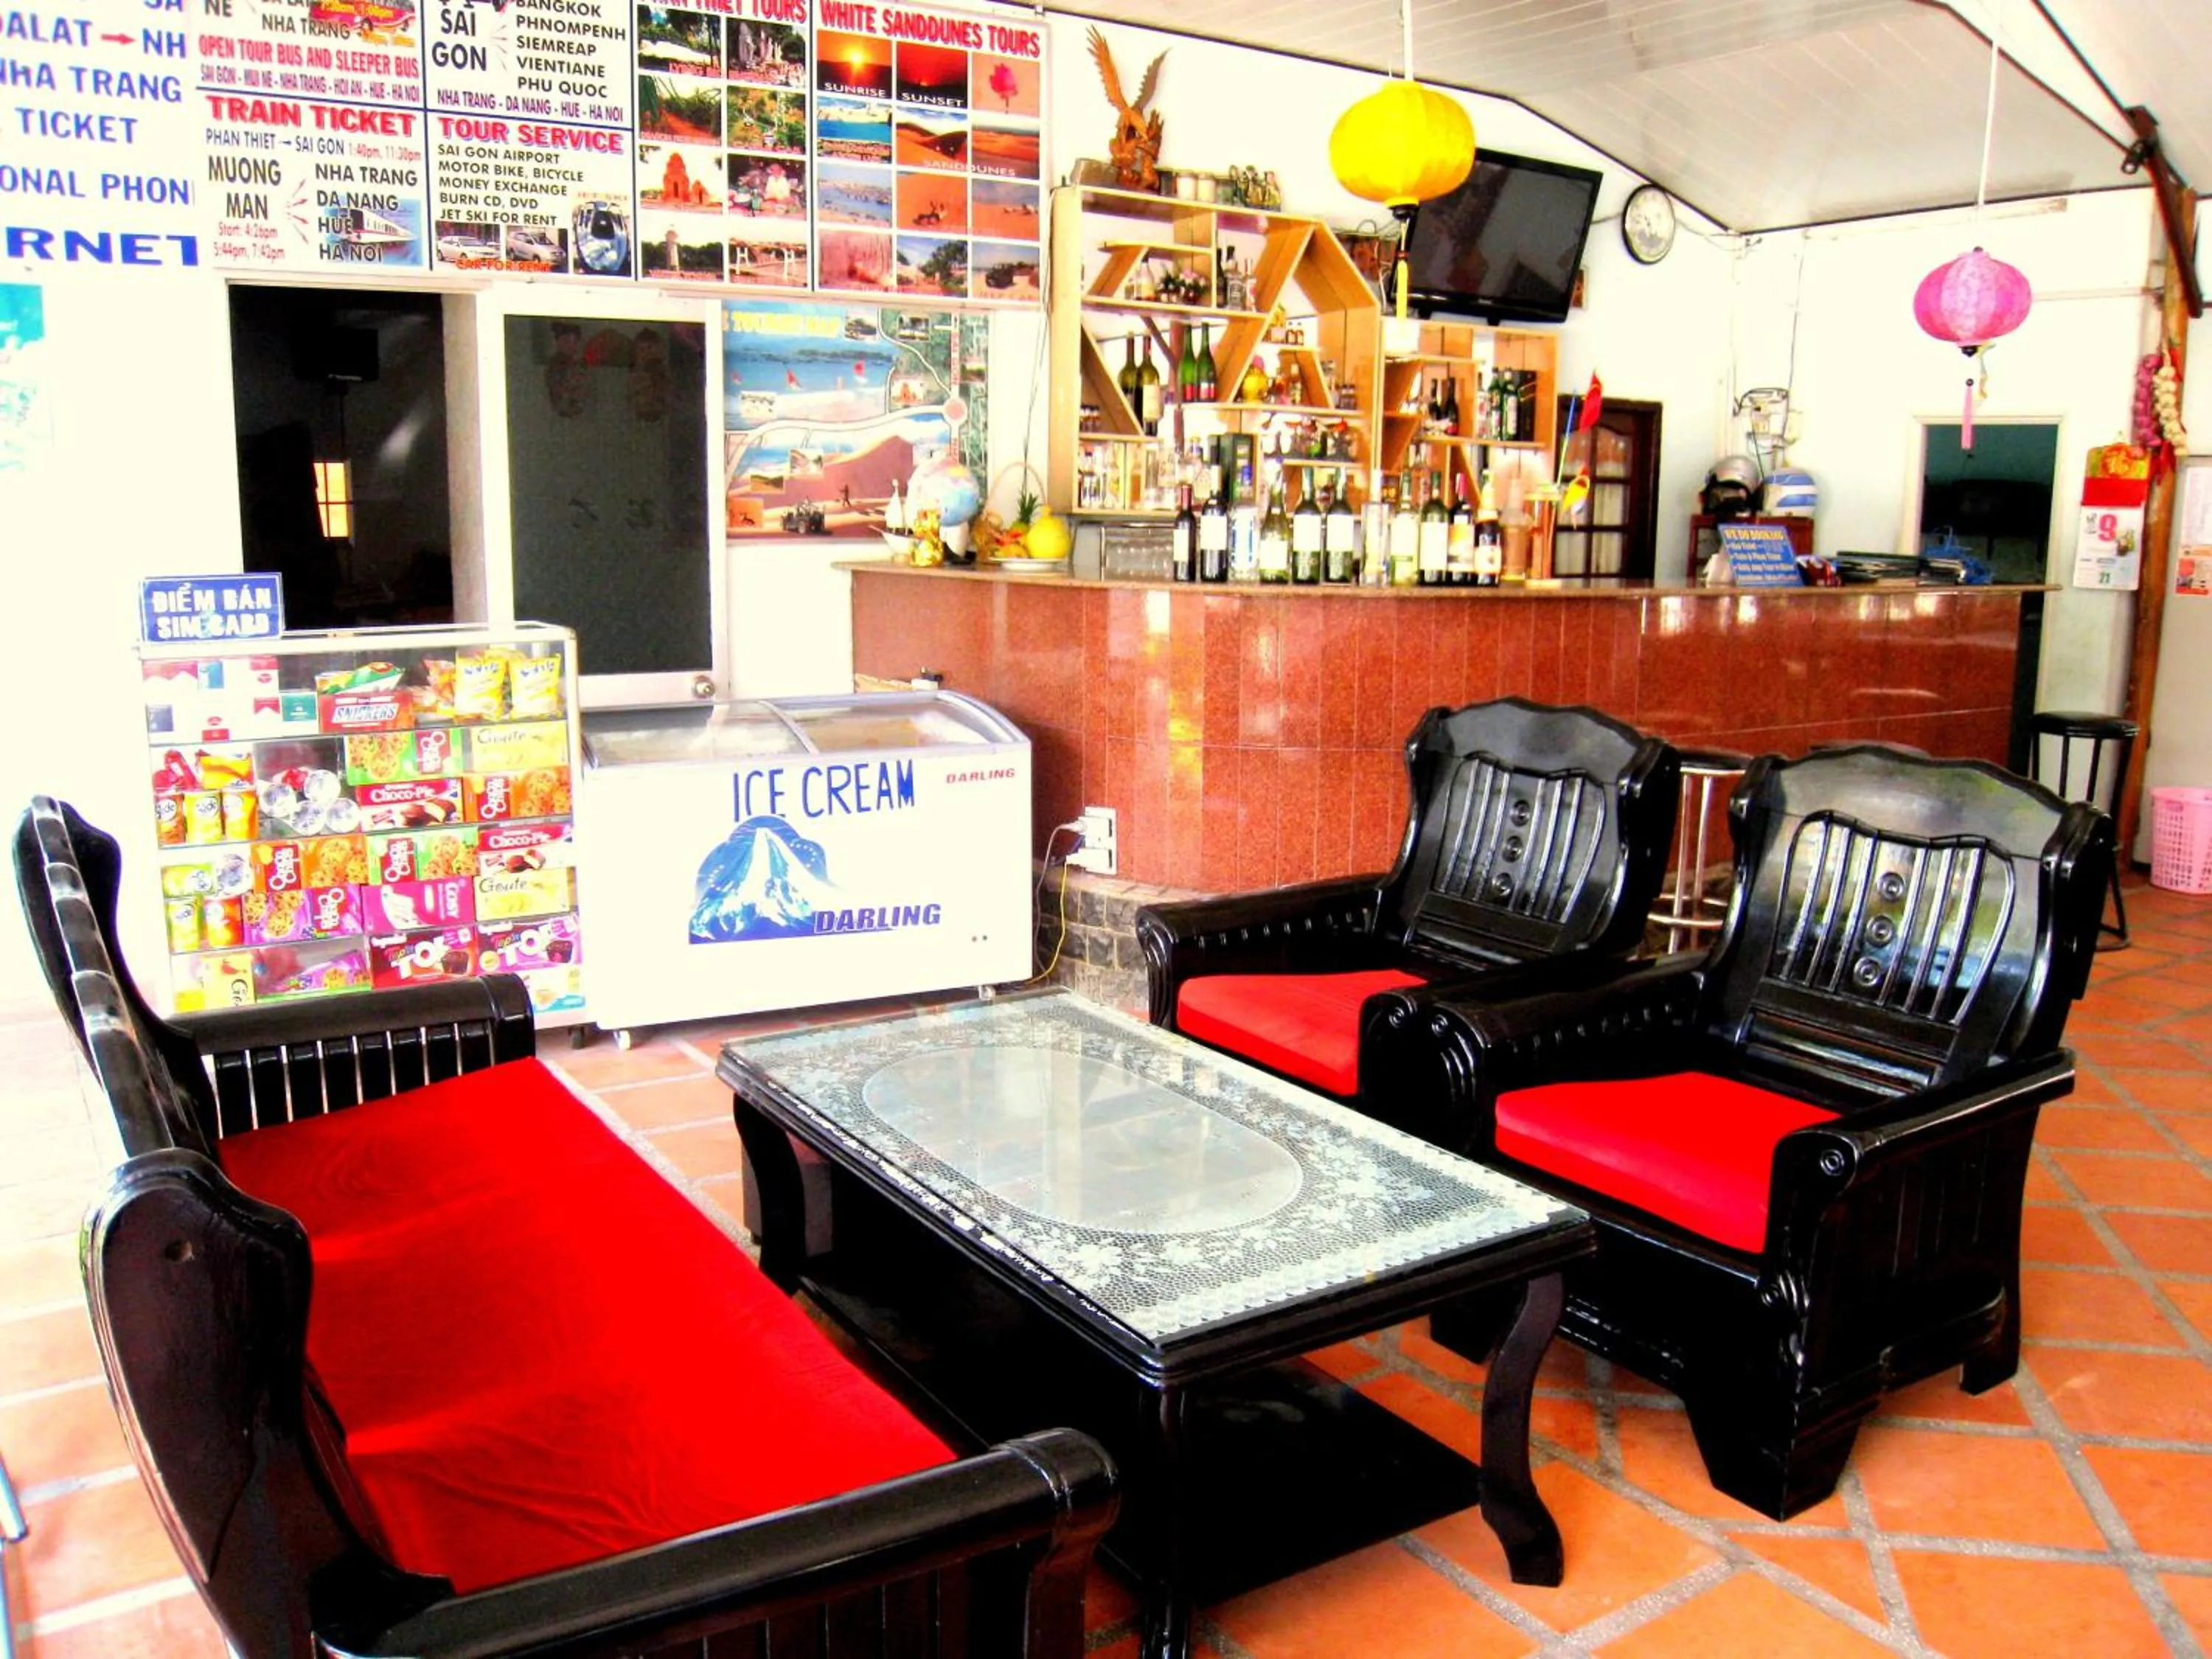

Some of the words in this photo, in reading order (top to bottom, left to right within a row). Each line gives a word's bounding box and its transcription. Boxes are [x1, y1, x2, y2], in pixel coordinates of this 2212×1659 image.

[516, 0, 602, 18] BANGKOK
[753, 0, 807, 24] TOURS
[262, 13, 296, 33] NHA
[300, 18, 350, 39] TRANG
[440, 8, 477, 37] SAI
[516, 14, 626, 41] PHNOMPENH
[818, 0, 877, 34] WHITE
[882, 8, 983, 49] SANDDUNES
[987, 25, 1040, 58] TOURS
[0, 11, 93, 47] ALAT
[142, 28, 186, 59] NH
[516, 35, 597, 57] SIEMREAP
[198, 35, 234, 58] OPEN
[237, 38, 273, 63] TOUR
[276, 43, 303, 67] BUS
[306, 46, 332, 70] AND
[335, 49, 391, 75] SLEEPER
[394, 56, 420, 79] BUS
[431, 41, 487, 72] GON
[516, 56, 606, 78] VIENTIANE
[68, 66, 181, 102] TRANG
[299, 73, 327, 94] TRANG
[518, 76, 552, 93] PHU
[558, 80, 608, 99] QUOC
[824, 82, 886, 98] SUNRISE
[437, 88, 460, 107] NHA
[462, 91, 496, 110] TRANG
[505, 95, 519, 111] DA
[521, 97, 552, 116] NANG
[561, 102, 581, 119] HUE
[589, 104, 603, 120] HA
[605, 107, 624, 123] NOI
[902, 92, 964, 107] SUNSET
[15, 107, 138, 144] TICKET
[205, 95, 302, 128] TRAIN
[309, 105, 417, 138] TICKET
[206, 128, 240, 147] PHAN
[243, 131, 276, 150] THIET
[295, 135, 313, 153] SAI
[317, 137, 344, 155] GON
[437, 116, 509, 145] TOUR
[517, 123, 625, 154] SERVICE
[437, 144, 461, 157] SAI
[465, 146, 499, 160] GON
[503, 149, 561, 164] AIRPORT
[208, 156, 282, 185] MUONG
[315, 163, 354, 182] NHA
[359, 167, 418, 187] TRANG
[438, 161, 490, 175] MOTOR
[494, 164, 529, 179] BIKE,
[532, 168, 585, 182] BICYCLE
[922, 160, 1016, 176] SANDDUNES
[101, 172, 189, 206] PHON
[438, 177, 490, 192] MONEY
[494, 181, 568, 196] EXCHANGE
[226, 192, 268, 220] MAN
[316, 189, 341, 207] DA
[347, 193, 399, 212] NANG
[439, 192, 479, 206] BURN
[483, 196, 506, 209] CD,
[509, 197, 540, 209] DVD
[318, 216, 354, 235] HUE
[439, 209, 462, 221] JET
[465, 210, 489, 223] SKI
[493, 212, 518, 224] FOR
[523, 215, 559, 227] RENT
[319, 243, 344, 261] HA
[349, 245, 383, 263] NOI
[2098, 512, 2117, 542] 9
[157, 616, 201, 639] SIM
[946, 768, 1015, 784] DARLING
[733, 768, 786, 822] ICE
[801, 759, 915, 818] CREAM
[815, 904, 942, 933] DARLING
